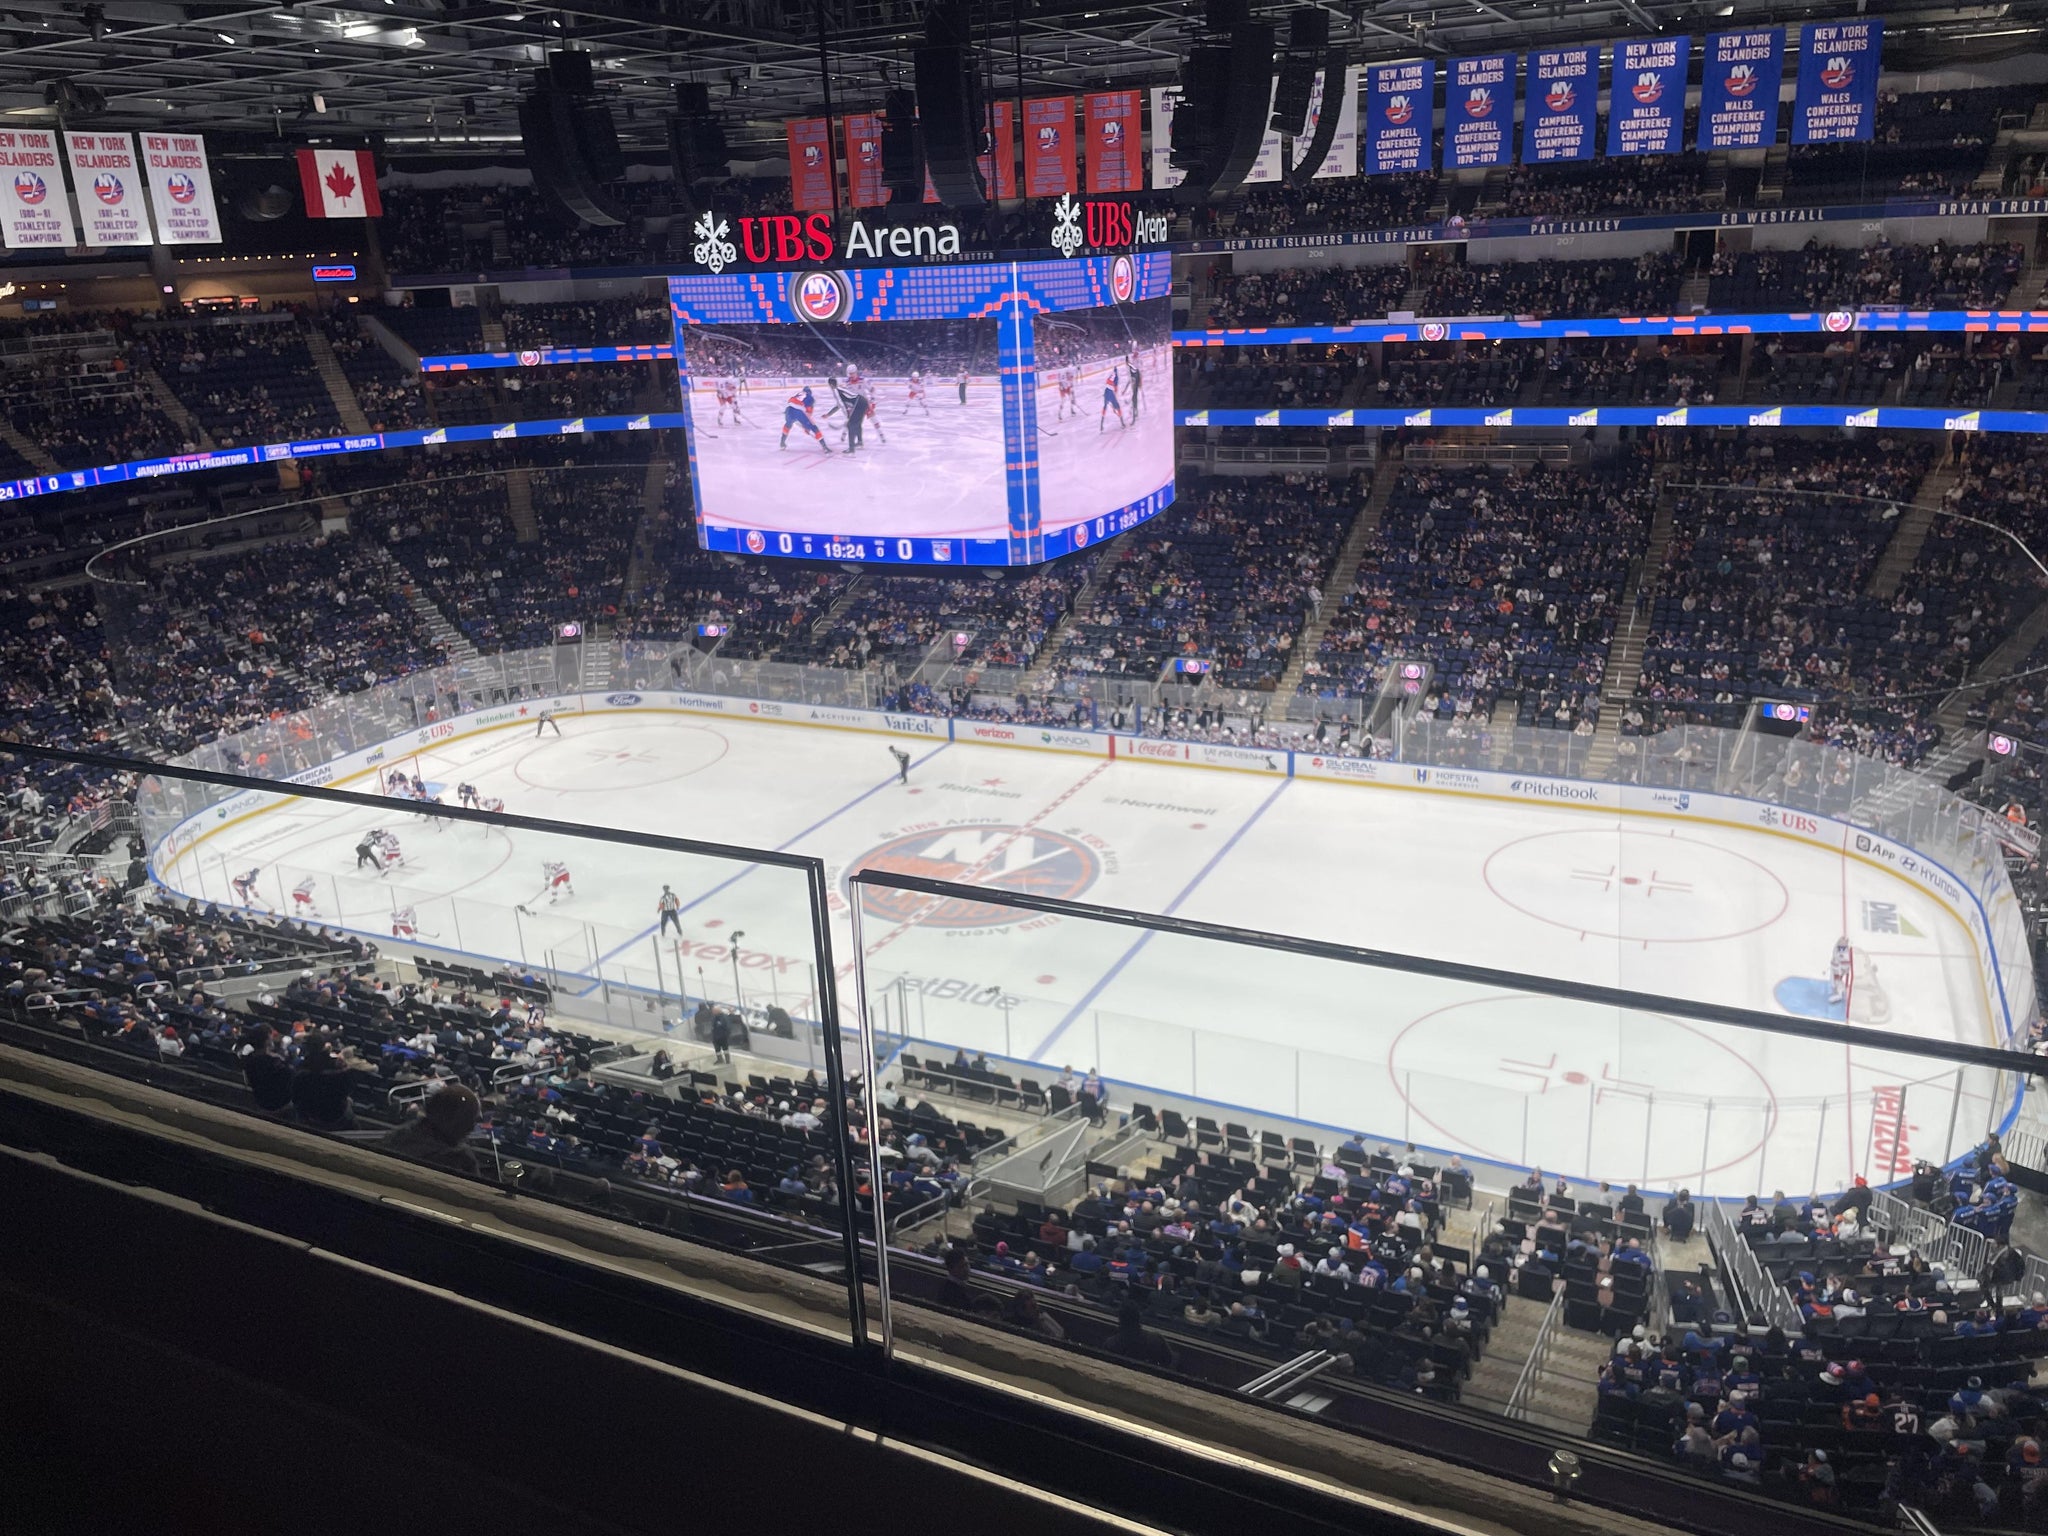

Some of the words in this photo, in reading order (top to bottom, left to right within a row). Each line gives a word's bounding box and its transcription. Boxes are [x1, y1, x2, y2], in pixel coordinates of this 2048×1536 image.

[1814, 27, 1838, 40] NEW
[1841, 25, 1868, 37] YORK
[1718, 36, 1741, 49] NEW
[1744, 33, 1771, 46] YORK
[1813, 39, 1868, 54] ISLANDERS
[1626, 44, 1648, 57] NEW
[1651, 41, 1677, 54] YORK
[1718, 47, 1770, 62] ISLANDERS
[1539, 54, 1560, 66] NEW
[1563, 51, 1587, 64] YORK
[1625, 55, 1676, 70] ISLANDERS
[1458, 61, 1478, 73] NEW
[1481, 58, 1504, 71] YORK
[1538, 64, 1587, 79] ISLANDERS
[1378, 69, 1397, 81] NEW
[1400, 66, 1423, 79] YORK
[1458, 71, 1504, 86] ISLANDERS
[1378, 79, 1423, 93] ISLANDERS
[1820, 92, 1850, 104] WALES
[1725, 100, 1754, 111] WALES
[1806, 104, 1862, 117] CONFERENCE
[1633, 107, 1660, 118] WALES
[1711, 111, 1765, 124] CONFERENCE
[1459, 121, 1498, 133] CAMPBELL
[1538, 115, 1579, 127] CAMPBELL
[1619, 117, 1671, 131] CONFERENCE
[1808, 116, 1859, 129] CHAMPIONS
[1380, 127, 1418, 139] CAMPBELL
[1534, 126, 1584, 138] CONFERENCE
[1621, 129, 1668, 142] CHAMPIONS
[1712, 123, 1762, 135] CHAMPIONS
[0, 133, 15, 148] EW
[20, 134, 50, 149] YORK
[72, 136, 96, 151] NEW
[99, 137, 127, 151] YORK
[147, 136, 169, 151] NEW
[172, 138, 198, 152] YORK
[1376, 138, 1422, 150] CONFERENCE
[1454, 131, 1501, 144] CONFERENCE
[1535, 136, 1581, 149] CHAMPIONS
[1378, 149, 1419, 160] CHAMPIONS
[1456, 142, 1499, 155] CHAMPIONS
[0, 152, 54, 167] SLANDERS
[75, 154, 131, 168] ISLANDERS
[150, 154, 203, 169] ISLANDERS
[1939, 202, 1990, 216] BRYAN
[1721, 213, 1738, 225] ED
[1747, 209, 1824, 224] WESTFALL
[14, 221, 45, 231] STANLEY
[47, 221, 61, 231] CUP
[94, 220, 124, 230] STANLEY
[125, 220, 139, 230] CUP
[168, 219, 196, 229] STANLEY
[197, 219, 210, 229] CUP
[1086, 201, 1131, 248] UBS
[1135, 210, 1168, 245] Arena
[1530, 223, 1555, 235] PAT
[1561, 219, 1621, 233] FLATLEY
[19, 233, 62, 243] CHAMPIONS
[98, 232, 140, 242] CHAMPIONS
[172, 231, 210, 240] CHAMPIONS
[738, 213, 834, 263] UBS
[845, 221, 960, 259] Arena
[1224, 239, 1247, 251] NEW
[1251, 237, 1278, 249] YORK
[1283, 234, 1343, 248] ISLANDERS
[1352, 232, 1382, 245] HALL
[1386, 231, 1399, 243] OF
[1403, 229, 1434, 242] FAME
[628, 420, 651, 431] DIME
[1185, 416, 1208, 426] DIME
[1255, 416, 1280, 426] DIME
[1328, 416, 1354, 426] DIME
[1405, 416, 1432, 426] DIME
[1484, 416, 1512, 426] DIME
[1568, 416, 1598, 426] DIME
[1656, 416, 1687, 427] DIME
[1749, 416, 1781, 427] DIME
[1845, 416, 1878, 427] DIME
[1945, 418, 1979, 431] DIME
[494, 429, 517, 439] DIME
[562, 424, 585, 435] DIME
[423, 434, 447, 445] DIME
[136, 462, 176, 478] JANUARY
[177, 460, 188, 471] 31
[188, 461, 199, 470] vs
[200, 453, 249, 470] PREDATORS
[49, 478, 59, 490] 0
[1147, 495, 1154, 515] 0
[1096, 517, 1105, 539] 0
[778, 533, 793, 554] 0
[804, 543, 812, 554] 0
[897, 539, 913, 560] 0
[824, 542, 866, 560] 19:24
[876, 546, 885, 558] 0
[612, 695, 635, 706] Ford
[679, 697, 723, 710] Northwell
[475, 711, 515, 727] Heineken
[884, 715, 935, 734] VanEck
[431, 721, 455, 739] UBS
[974, 727, 1015, 740] verizon
[366, 751, 384, 764] DIME
[1326, 758, 1376, 771] GLOBAL
[1436, 771, 1479, 784] HOFSTRA
[938, 782, 1022, 800] Heineken
[1523, 782, 1598, 801] PitchBook
[1120, 799, 1217, 817] Northwell
[1782, 813, 1818, 833] UBS
[1920, 866, 1960, 902] HYUNDAI
[666, 938, 799, 975] xerox
[876, 971, 1022, 1012] jetBlue
[1872, 1086, 1919, 1174] verizon
[1894, 1412, 1919, 1435] 27
